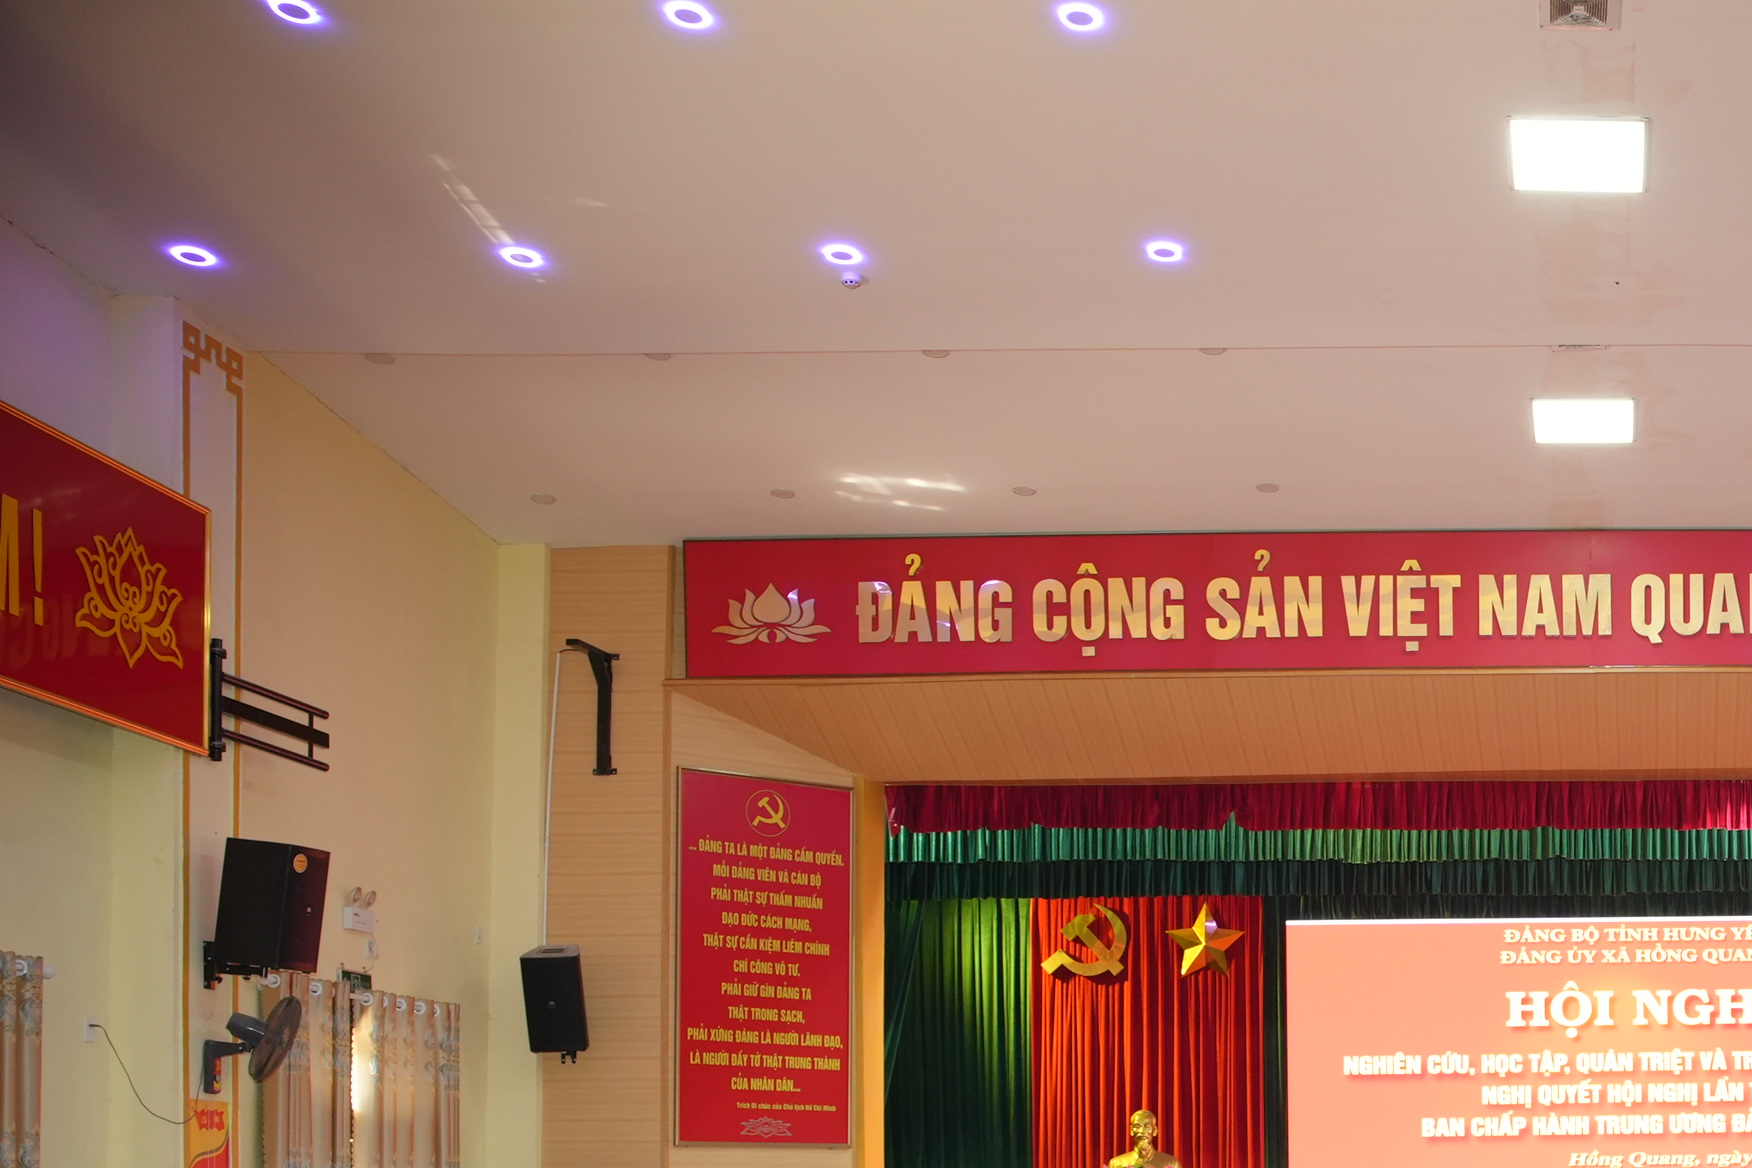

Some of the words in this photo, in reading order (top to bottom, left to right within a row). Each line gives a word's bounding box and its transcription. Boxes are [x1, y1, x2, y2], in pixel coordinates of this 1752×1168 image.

[856, 553, 1012, 643] ĐẢNG
[1032, 562, 1185, 656] CỘNG
[1205, 549, 1323, 640] SẢN
[1342, 559, 1461, 652] VIỆT
[1478, 573, 1611, 639] NAM
[732, 861, 755, 880] ĐẢNG
[757, 867, 776, 882] VIÊN
[778, 869, 789, 883] VÀ
[791, 870, 808, 885] CÁN
[810, 872, 821, 889] BỘ
[721, 911, 739, 927] ĐẠO
[741, 910, 758, 927] ĐỨC
[760, 913, 783, 929] CÁCH
[1503, 925, 1566, 943] ĐẢNG
[1571, 925, 1600, 945] BỘ
[1604, 924, 1659, 942] TỈNH
[1663, 926, 1726, 941] HƯNG
[1500, 946, 1562, 964] ĐẢNG
[1567, 946, 1597, 964] ỦY
[1601, 947, 1630, 963] XÃ
[1635, 943, 1698, 963] HỒNG
[721, 978, 741, 995] PHẢI
[760, 982, 775, 998] GÌN
[776, 981, 799, 1000] ĐẢNG
[801, 988, 812, 1000] TA
[728, 1004, 749, 1022] THẬT
[750, 1007, 778, 1021] TRONG
[1505, 980, 1614, 1038] HỘI
[1343, 1051, 1422, 1076] NGHIÊN
[1427, 1050, 1475, 1076] CỨU,
[1481, 1054, 1523, 1077] HỌC
[1528, 1050, 1570, 1077] TẬP,
[1576, 1049, 1634, 1074] QUÁN
[1638, 1048, 1695, 1075] TRIỆT
[1699, 1047, 1727, 1071] VÀ
[731, 1072, 749, 1090] CỦA
[750, 1075, 774, 1091] NHÂN
[1482, 1085, 1532, 1108] NGHỊ
[1537, 1078, 1602, 1106] QUYẾT
[1607, 1080, 1643, 1107] HỘI
[1648, 1082, 1698, 1106] NGHỊ
[1704, 1076, 1744, 1102] LẦN
[1421, 1117, 1465, 1137] BAN
[1470, 1110, 1527, 1136] CHẤP
[1532, 1112, 1589, 1135] HÀNH
[1595, 1114, 1664, 1135] TRUNG
[1669, 1112, 1726, 1134] ƯƠNG
[1568, 1149, 1624, 1168] Hồng
[1628, 1152, 1701, 1168] Quang,
